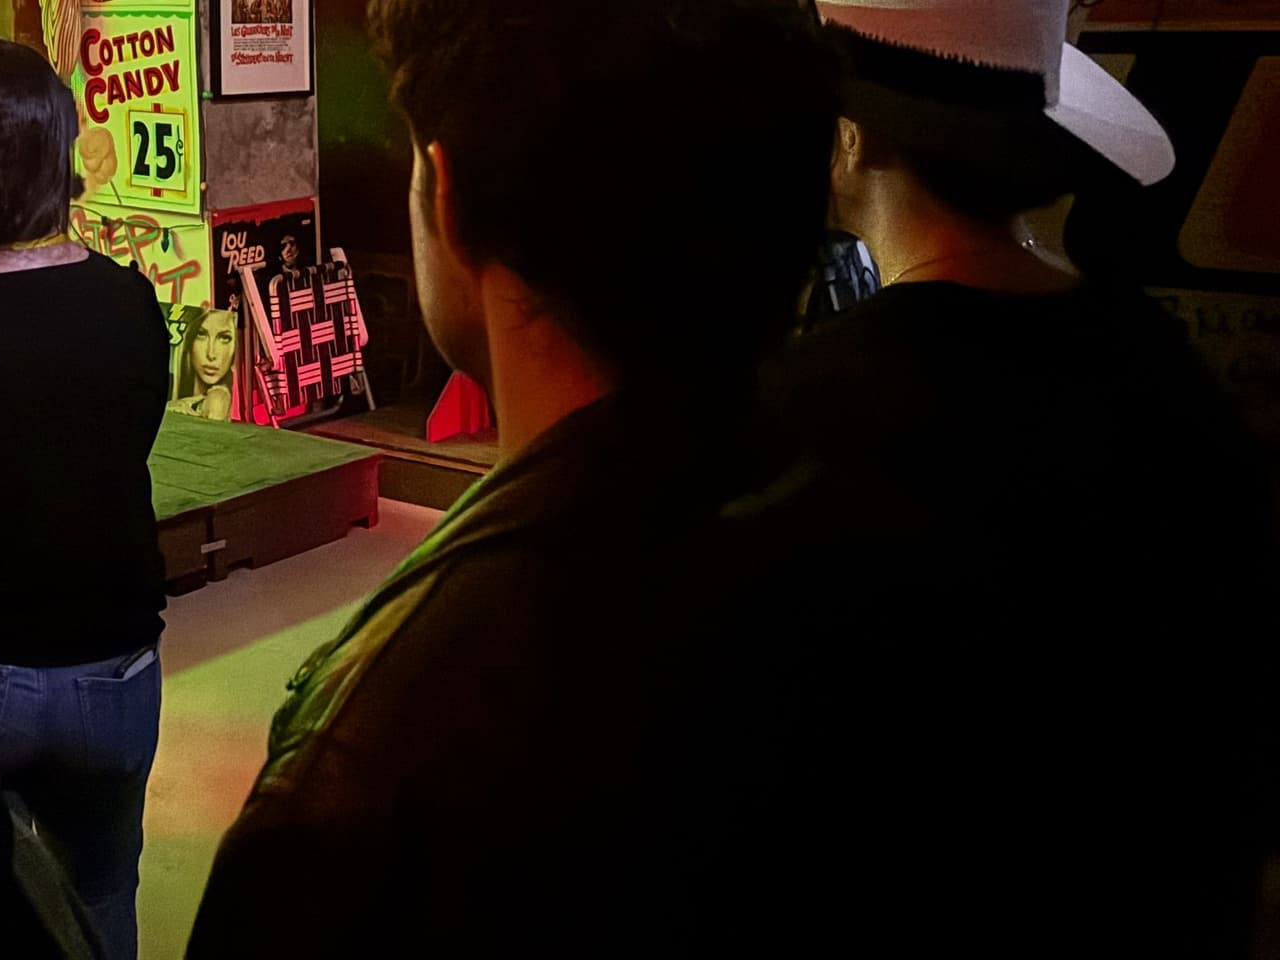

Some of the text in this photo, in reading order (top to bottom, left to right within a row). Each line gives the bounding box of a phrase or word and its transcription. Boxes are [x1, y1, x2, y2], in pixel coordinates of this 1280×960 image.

[80, 25, 175, 76] COTTON
[85, 60, 180, 123] CANDY
[221, 230, 247, 258] LOU
[227, 244, 266, 274] REED
